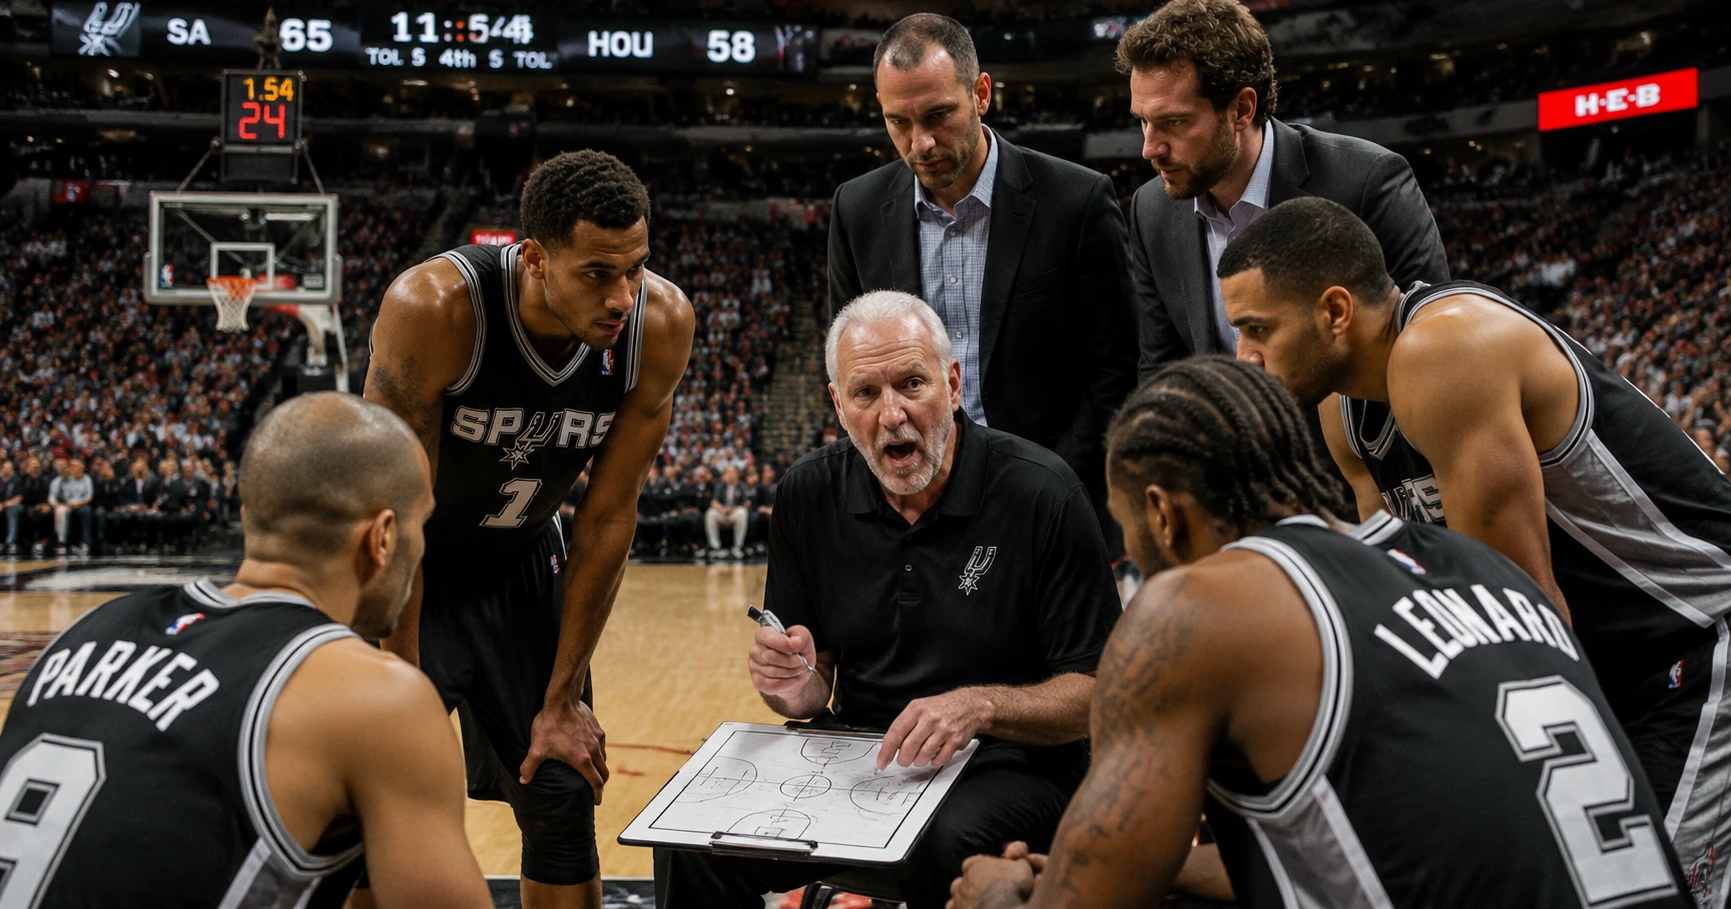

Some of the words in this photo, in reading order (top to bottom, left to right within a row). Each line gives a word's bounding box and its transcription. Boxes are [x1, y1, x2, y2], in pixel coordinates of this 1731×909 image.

[167, 18, 211, 45] SA
[280, 18, 333, 52] 65
[366, 47, 404, 66] TOL
[439, 48, 477, 68] 4th
[513, 51, 552, 69] TOL
[588, 31, 654, 57] HOU
[707, 30, 755, 62] 58
[238, 102, 285, 139] 24
[451, 405, 617, 455] SPURS
[479, 477, 543, 528] 1
[1373, 584, 1580, 680] LEONARD
[27, 640, 220, 732] PARKER
[1495, 675, 1679, 909] 2
